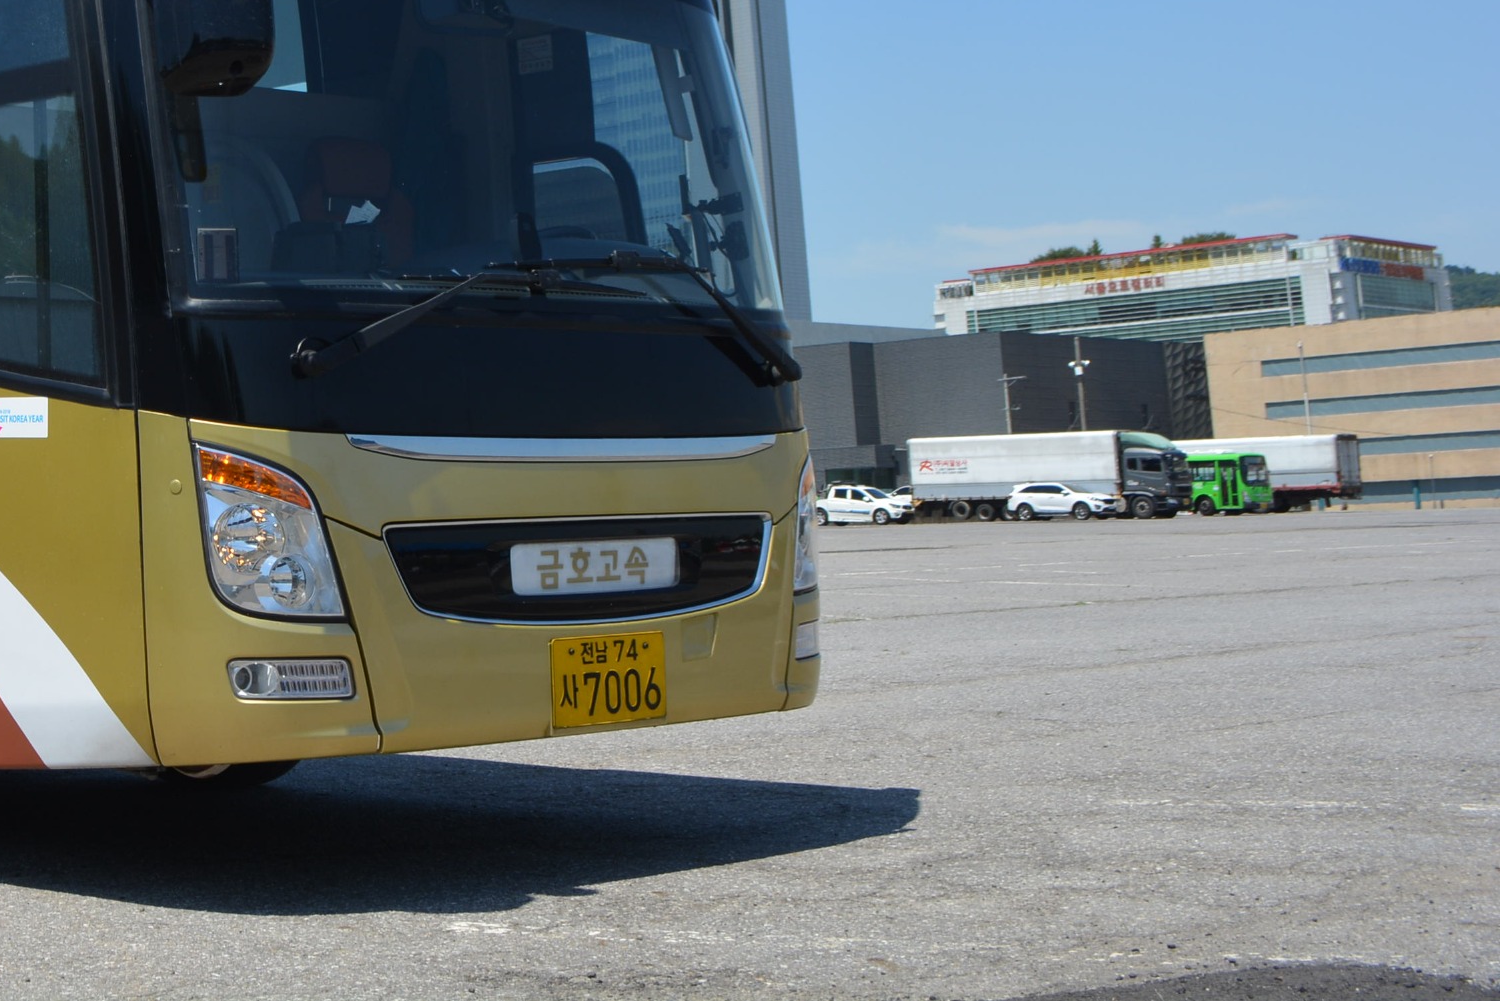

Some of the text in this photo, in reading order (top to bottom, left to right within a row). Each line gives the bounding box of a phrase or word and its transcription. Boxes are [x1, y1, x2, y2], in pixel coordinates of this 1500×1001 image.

[9, 414, 28, 423] KOREA
[28, 414, 44, 423] YEAR
[537, 546, 649, 590] 금호고속
[580, 639, 638, 664] 전남 74
